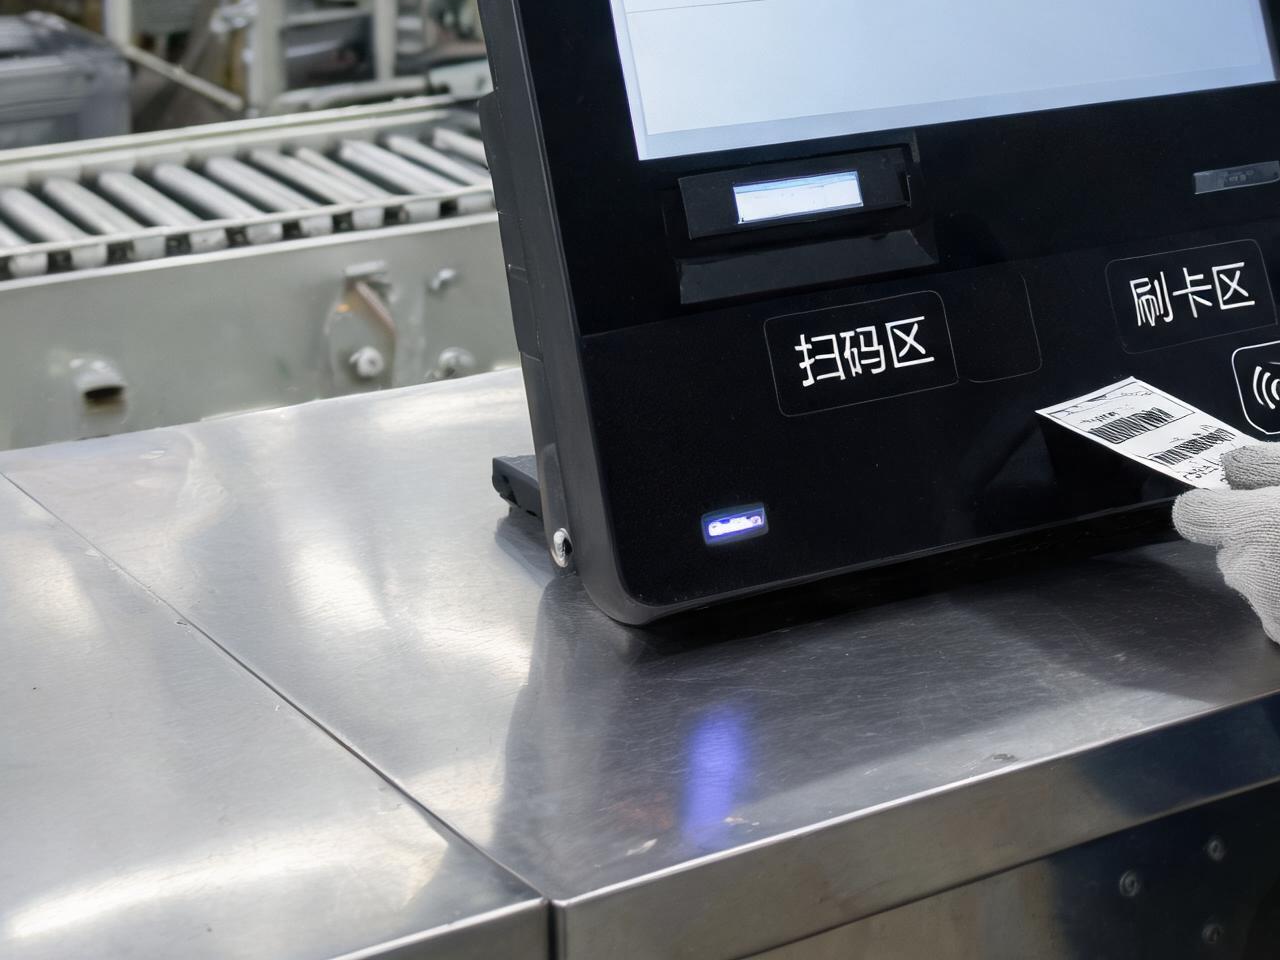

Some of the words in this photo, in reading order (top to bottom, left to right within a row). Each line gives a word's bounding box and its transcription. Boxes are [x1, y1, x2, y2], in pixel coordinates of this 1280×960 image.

[1129, 261, 1256, 327] 刷卡区
[794, 315, 935, 387] 扫码区
